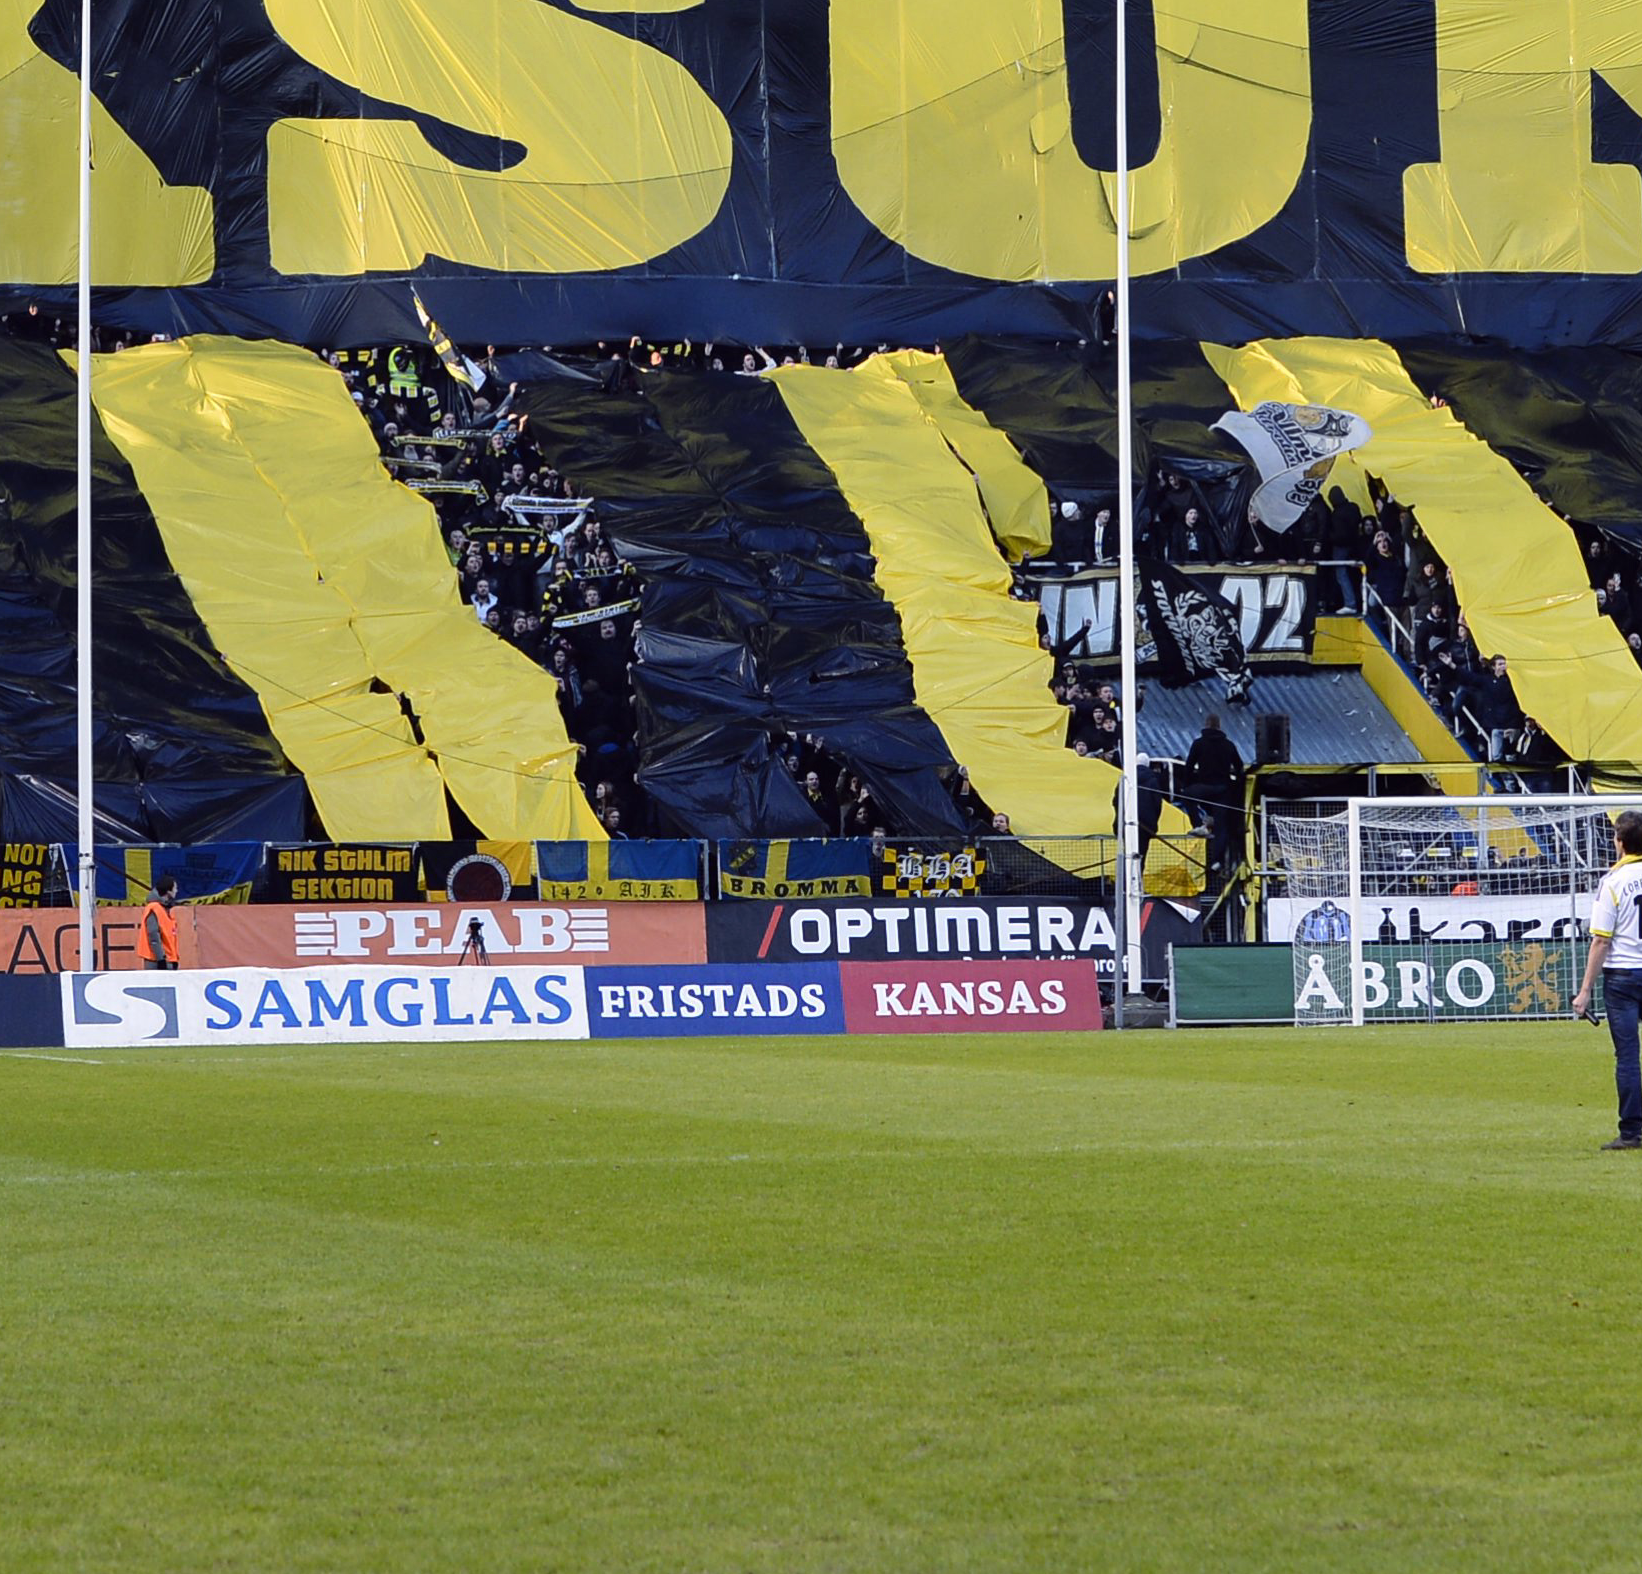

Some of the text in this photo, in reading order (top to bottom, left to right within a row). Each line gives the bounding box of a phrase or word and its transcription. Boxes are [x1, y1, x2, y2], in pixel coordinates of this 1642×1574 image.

[4, 843, 48, 866] NOT
[278, 850, 317, 872] AIK
[731, 878, 860, 899] BROMMA
[330, 908, 574, 957] PEAB
[789, 907, 1118, 954] OPTIMERA
[872, 979, 1067, 1016] KANSAS
[1294, 953, 1496, 1009] ÅBRO
[204, 975, 571, 1030] SAMGLAS
[598, 983, 826, 1019] FRISTADS
